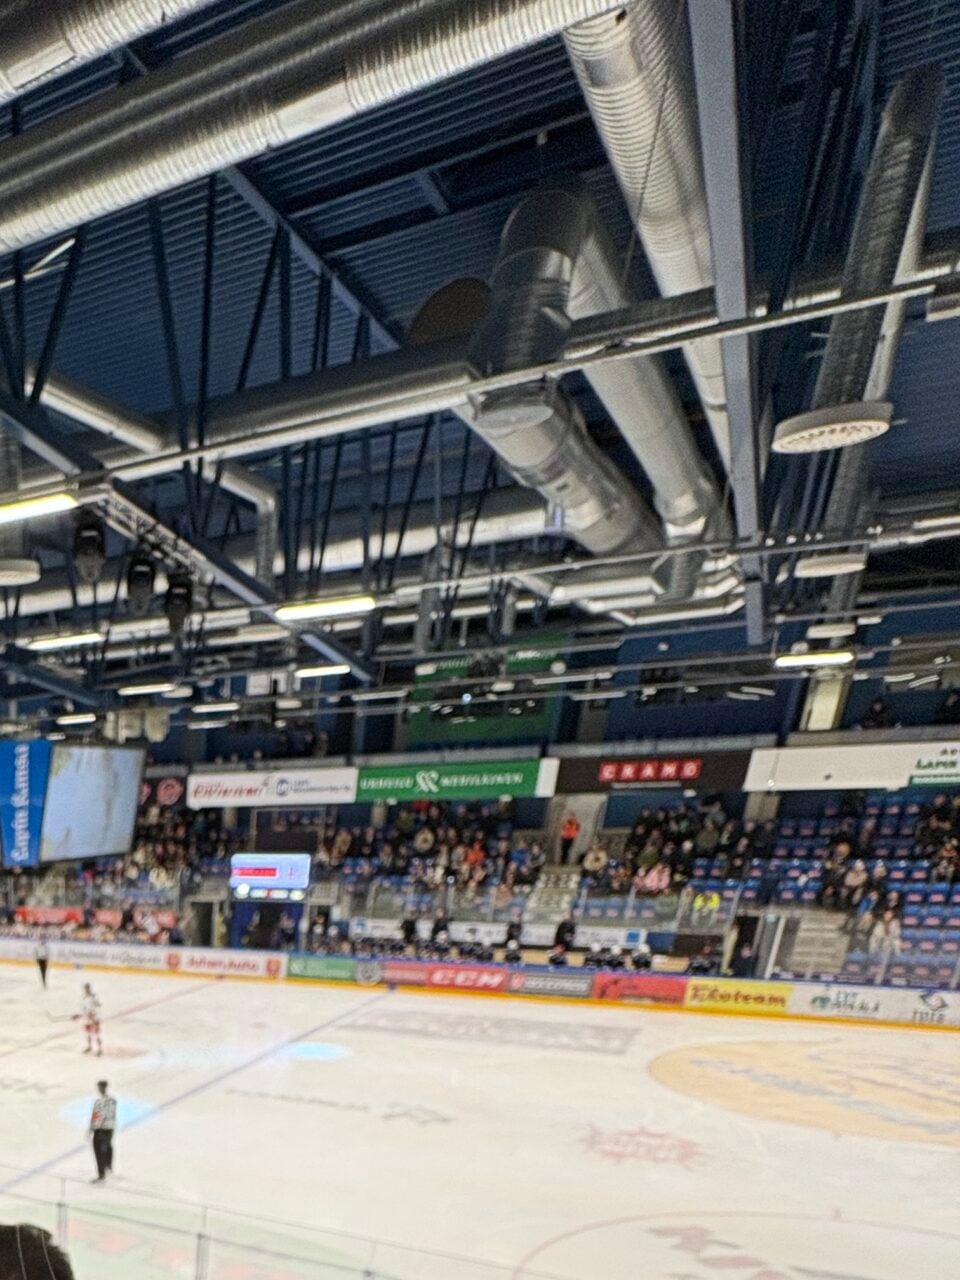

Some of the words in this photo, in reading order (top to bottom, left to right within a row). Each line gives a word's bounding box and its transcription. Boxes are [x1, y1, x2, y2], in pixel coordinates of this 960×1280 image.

[10, 744, 30, 808] Kansa
[600, 762, 698, 780] CRAMO
[431, 969, 506, 988] CCM
